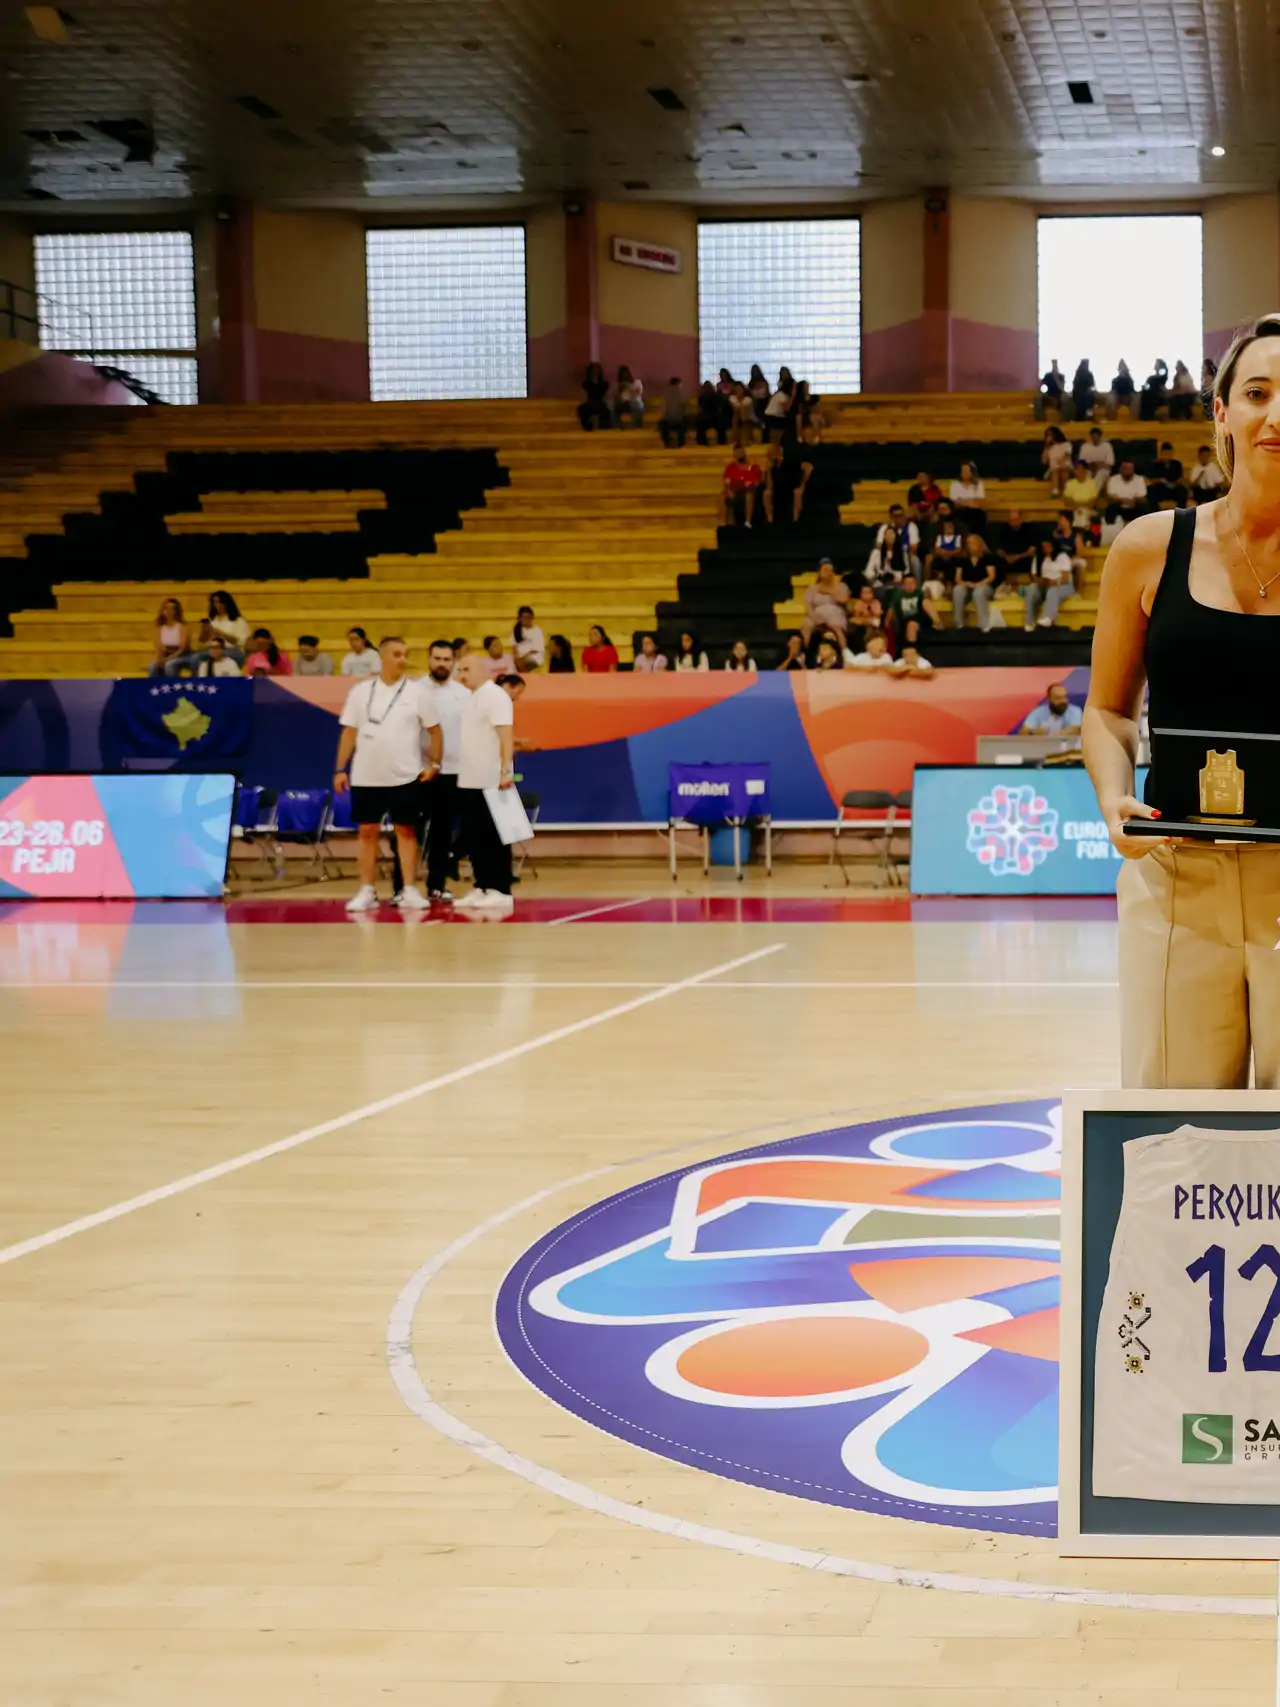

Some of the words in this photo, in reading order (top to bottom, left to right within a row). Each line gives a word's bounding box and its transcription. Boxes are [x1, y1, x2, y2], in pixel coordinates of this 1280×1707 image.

[677, 781, 730, 796] molten
[1063, 821, 1109, 840] EURO
[1076, 840, 1109, 860] FOR
[12, 847, 76, 874] PEJA
